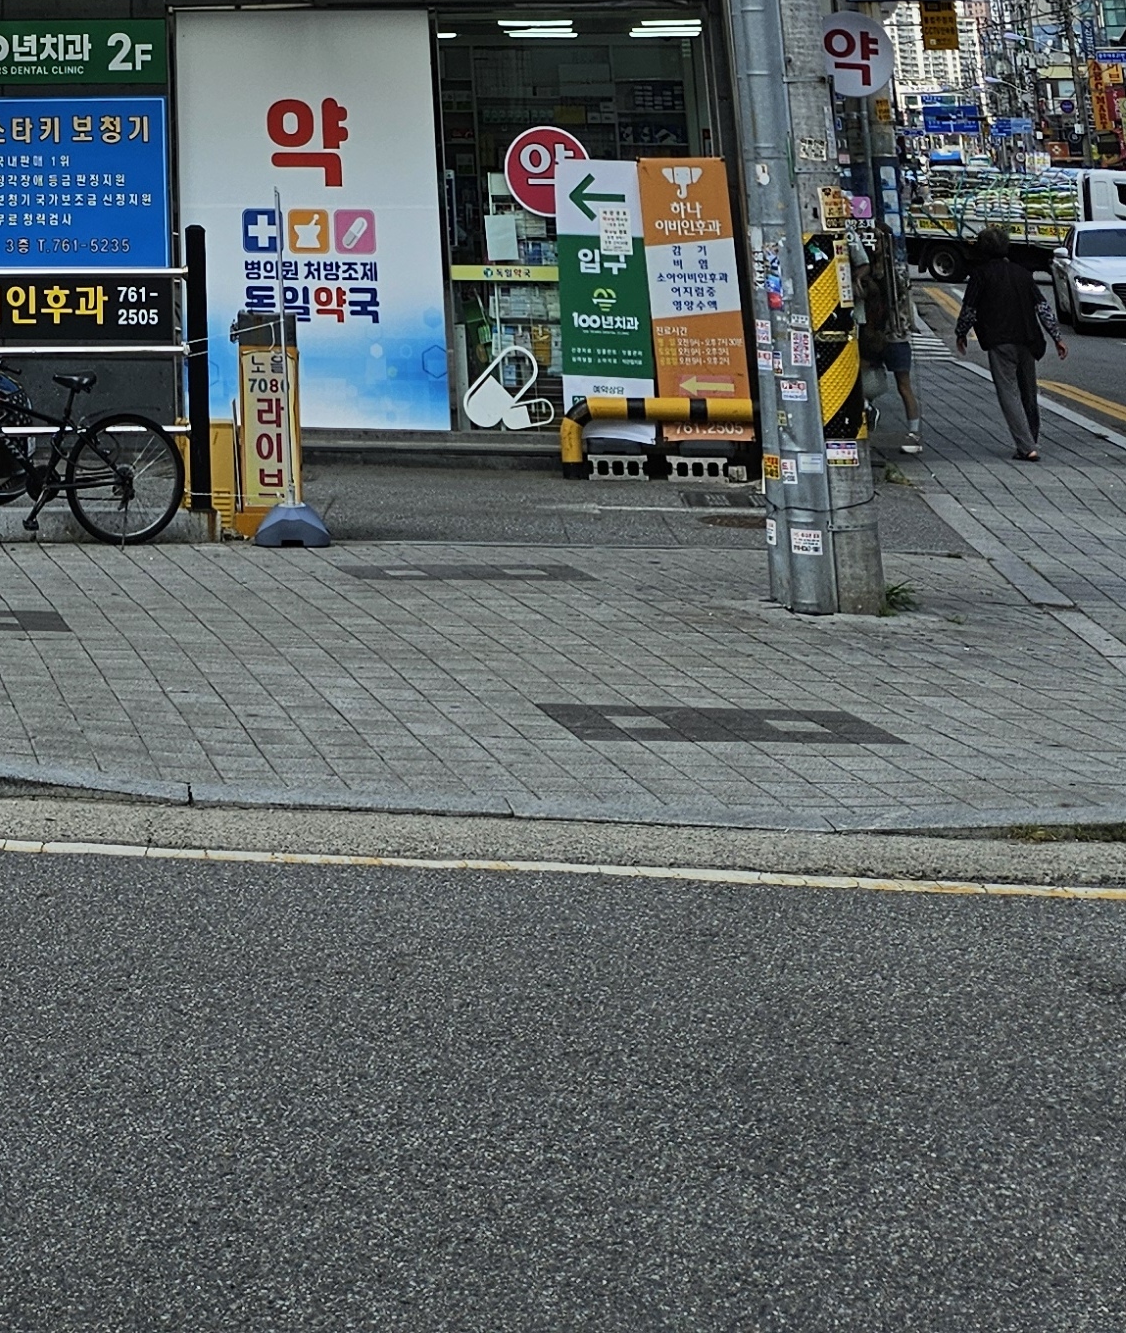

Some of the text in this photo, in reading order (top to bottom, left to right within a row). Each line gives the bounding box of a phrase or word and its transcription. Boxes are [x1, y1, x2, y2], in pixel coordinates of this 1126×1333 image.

[106, 32, 153, 71] 2F
[824, 28, 879, 86] 약
[10, 66, 49, 76] DENTAL
[51, 65, 85, 75] CLINIC
[71, 115, 150, 144] 보청기
[267, 97, 349, 187] 약
[76, 173, 126, 188] 판정지원
[35, 193, 98, 208] 국가보조금
[670, 201, 703, 219] 하나
[23, 213, 72, 226] 청력검사
[655, 219, 722, 237] 이비인후과
[5, 238, 131, 254] 3층 T.761-5235
[244, 259, 379, 283] 병의원 처방조제
[577, 248, 628, 276] 입구
[496, 268, 532, 278] 독일약국
[117, 286, 159, 303] 761-
[671, 286, 717, 298] 어지럼증
[244, 285, 381, 324] 독일약국
[672, 299, 719, 312] 영양수액
[117, 308, 159, 326] 2505
[572, 311, 640, 331] 100년치과
[250, 355, 285, 375] 노을
[255, 398, 285, 499] 라이브
